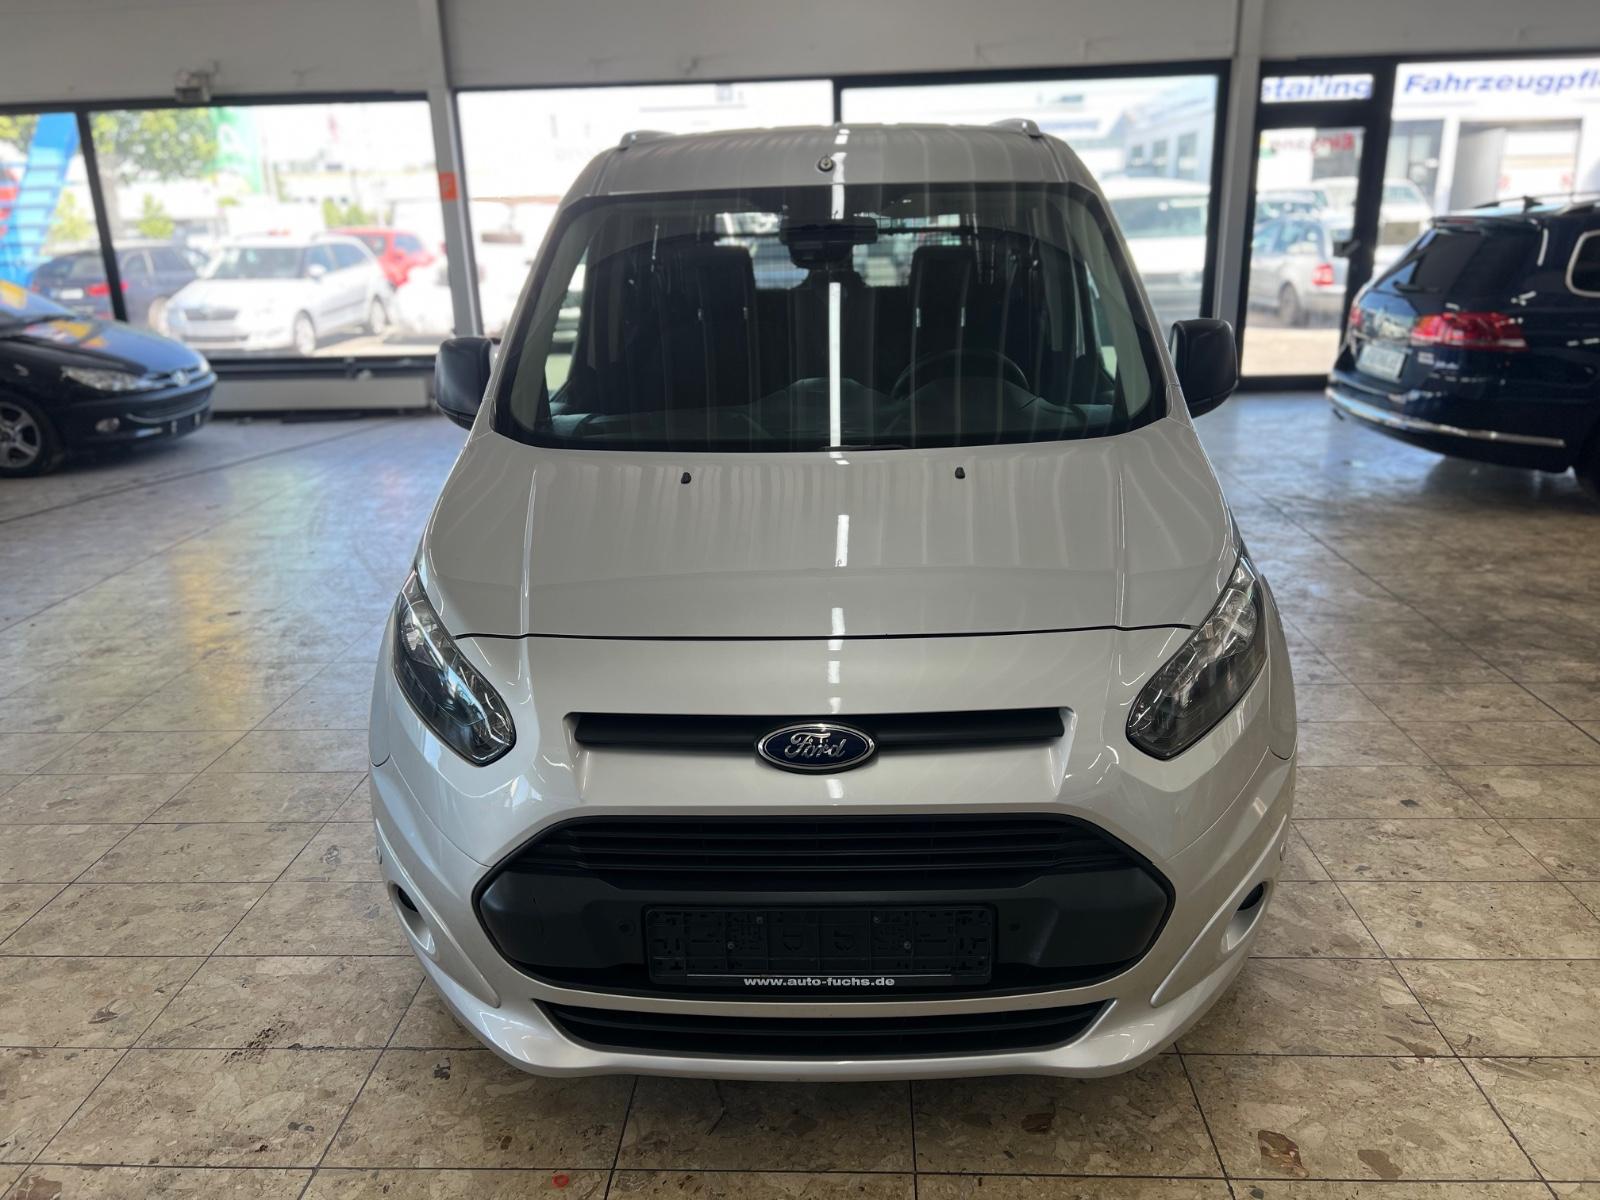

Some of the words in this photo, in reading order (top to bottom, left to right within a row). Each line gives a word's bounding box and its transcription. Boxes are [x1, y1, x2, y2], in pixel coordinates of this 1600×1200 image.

[1404, 68, 1600, 96] Fahrzeugpfl
[784, 731, 847, 758] Ford
[743, 976, 896, 987] www.auto-fuchs.de
